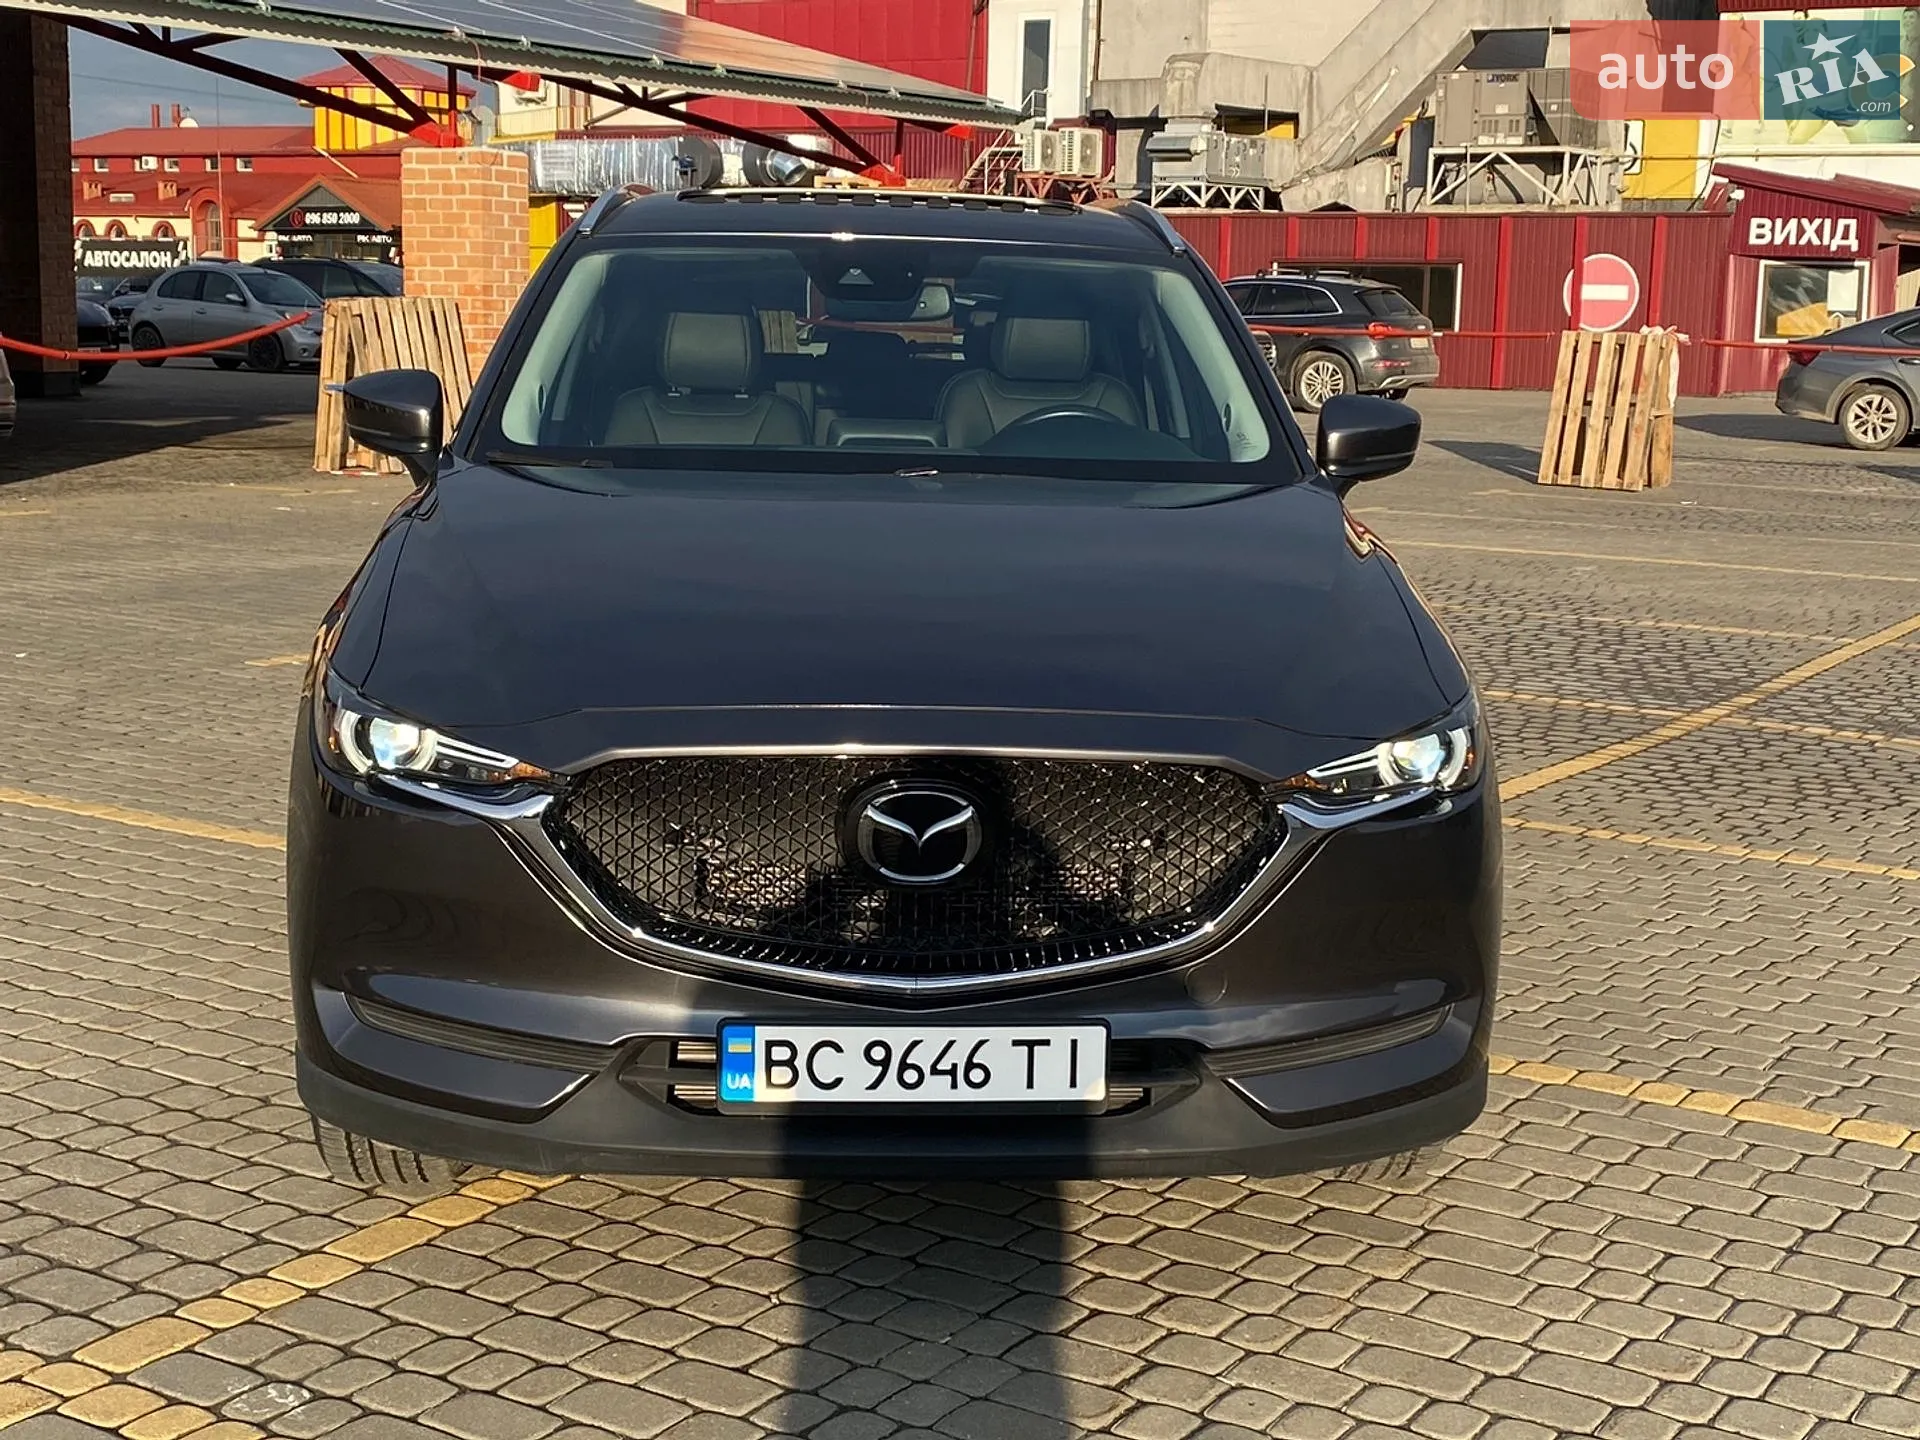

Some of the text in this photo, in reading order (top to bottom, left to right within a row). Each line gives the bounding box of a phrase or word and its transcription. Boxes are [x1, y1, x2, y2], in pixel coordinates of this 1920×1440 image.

[305, 212, 360, 224] 096 850 2000
[1748, 217, 1859, 252] ВИХІД
[83, 250, 173, 268] АВТОСАЛОН
[765, 1039, 844, 1090] BC
[863, 1039, 991, 1090] 9646
[727, 1073, 752, 1089] UA
